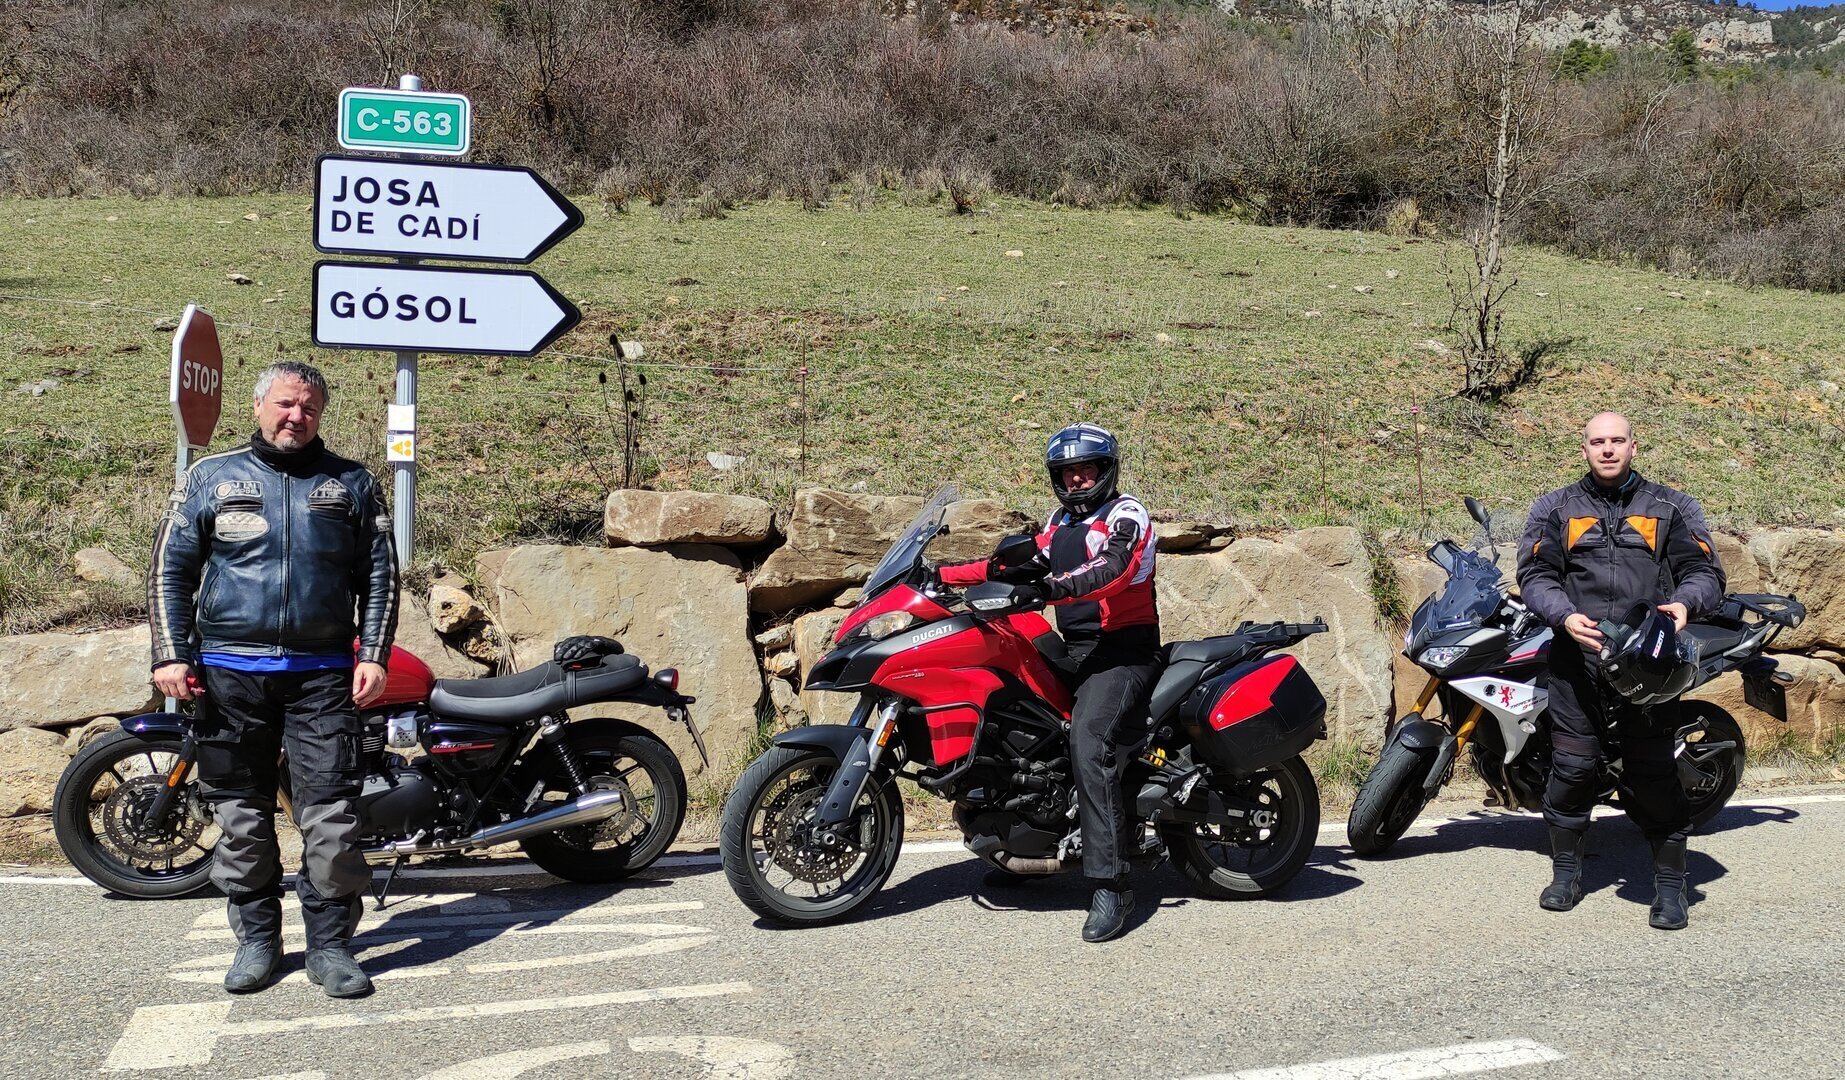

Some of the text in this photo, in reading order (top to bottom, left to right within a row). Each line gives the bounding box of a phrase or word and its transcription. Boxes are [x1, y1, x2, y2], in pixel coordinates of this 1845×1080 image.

[357, 107, 452, 136] C-563
[332, 176, 440, 208] JOSA
[331, 210, 481, 241] DE CADÍ
[330, 287, 477, 325] GÓSOL
[182, 360, 219, 397] STOP
[911, 624, 953, 644] DUCATI
